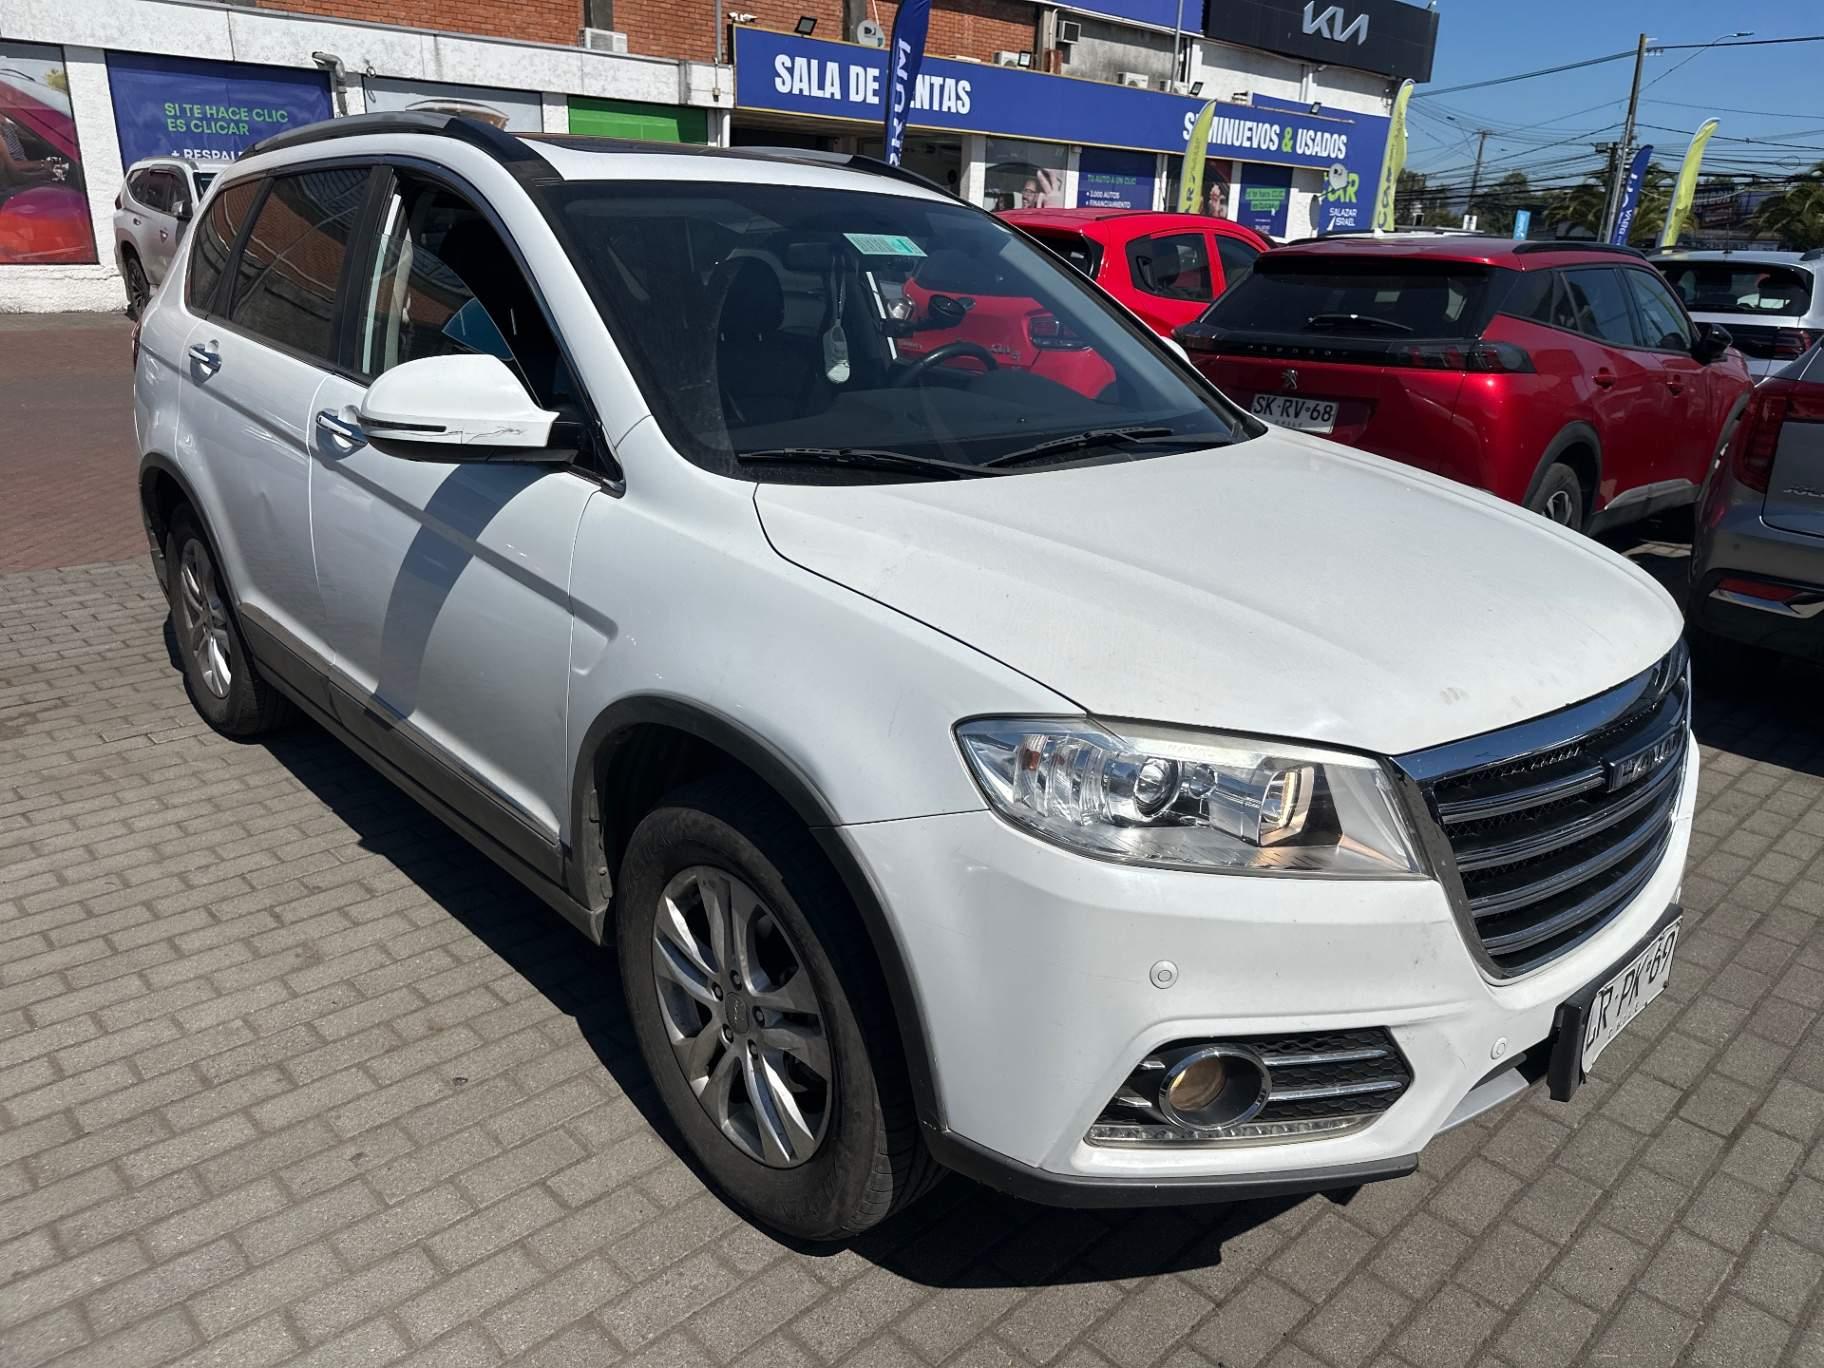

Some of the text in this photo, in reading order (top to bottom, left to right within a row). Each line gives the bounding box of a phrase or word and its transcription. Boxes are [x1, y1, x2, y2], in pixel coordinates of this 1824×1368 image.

[774, 54, 841, 100] SALA
[849, 65, 880, 105] DE
[164, 103, 289, 123] SI TE HACE CLIC
[167, 119, 249, 135] ES CLICAR
[1281, 127, 1293, 153] &
[1295, 128, 1347, 160] USADOS
[1329, 207, 1358, 218] SALAZAR
